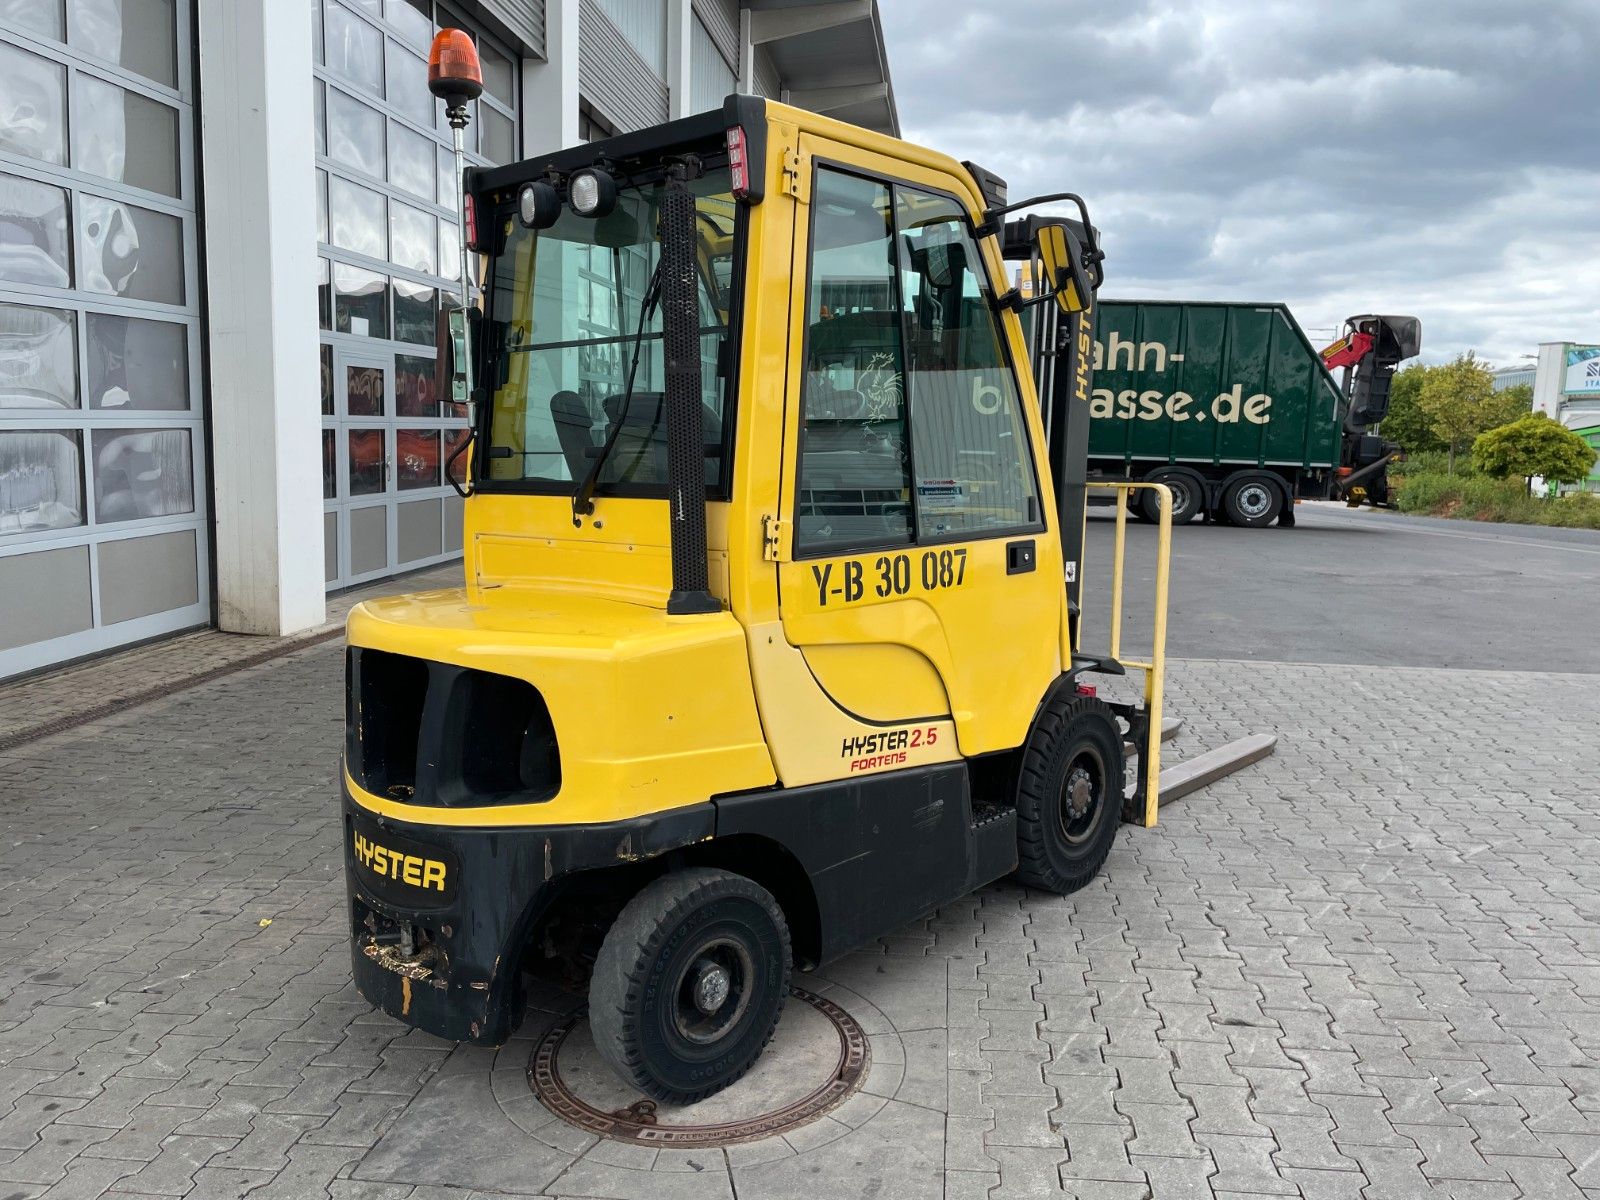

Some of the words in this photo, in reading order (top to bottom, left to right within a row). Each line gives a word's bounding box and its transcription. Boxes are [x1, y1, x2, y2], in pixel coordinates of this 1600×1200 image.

[1090, 384, 1272, 425] asse.de
[811, 560, 864, 606] Y-B
[875, 554, 910, 598] 30
[922, 548, 967, 591] 087
[841, 730, 909, 758] HYSTER
[910, 727, 937, 748] 2.5
[354, 830, 447, 892] HYSTER
